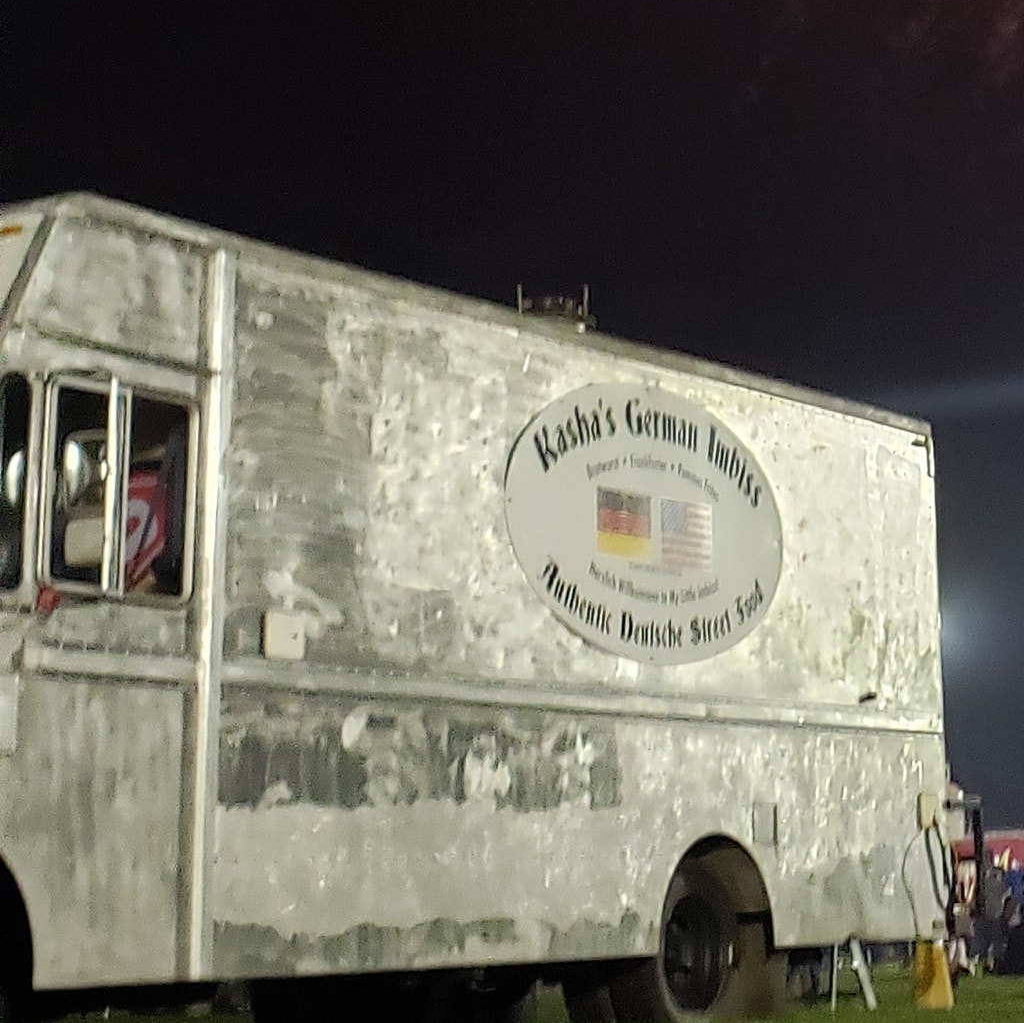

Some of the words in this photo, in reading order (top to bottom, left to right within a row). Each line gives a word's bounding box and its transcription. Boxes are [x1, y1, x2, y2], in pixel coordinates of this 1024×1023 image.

[533, 397, 616, 473] Kasha's
[625, 399, 698, 453] German
[707, 424, 762, 508] Imbiss
[537, 558, 611, 635] Authentic
[620, 610, 682, 648] Deutsche
[690, 616, 731, 646] Street
[735, 578, 763, 626] Food
